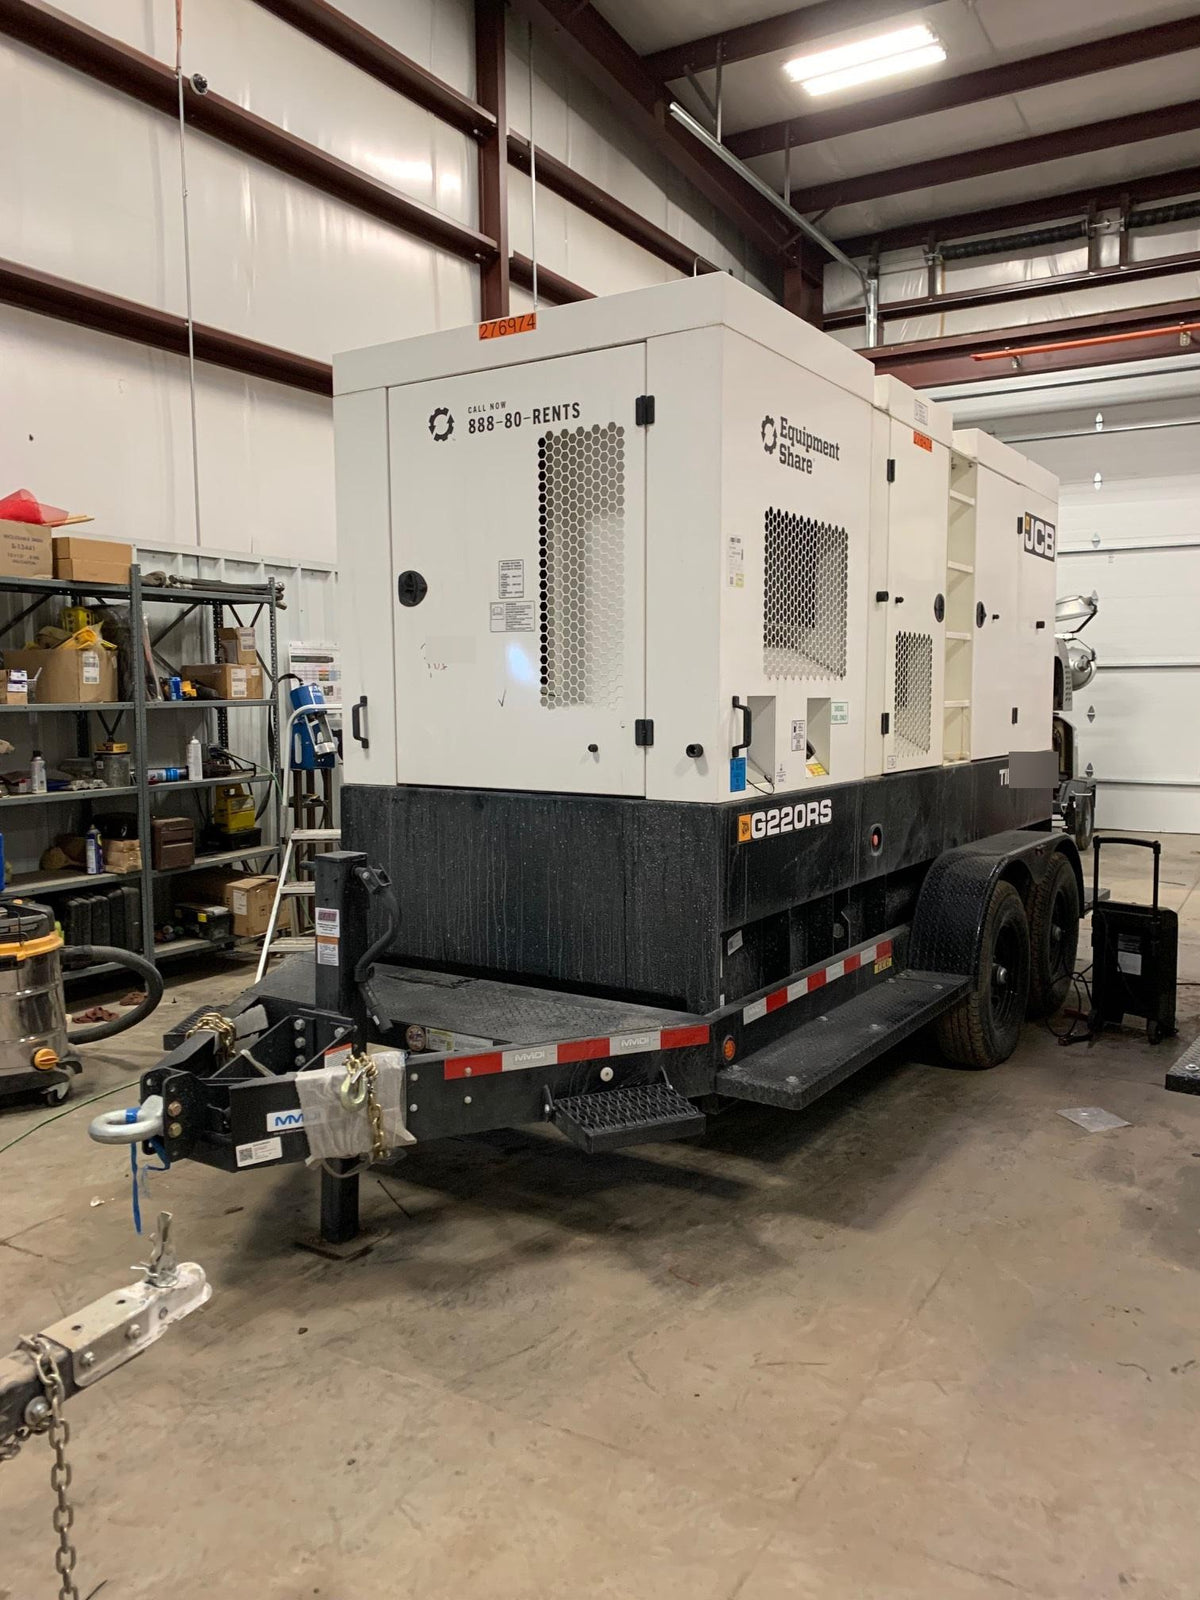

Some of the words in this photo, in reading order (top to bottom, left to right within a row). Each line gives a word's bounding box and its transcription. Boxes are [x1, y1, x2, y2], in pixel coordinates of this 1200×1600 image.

[480, 314, 536, 339] 276974
[468, 404, 486, 413] CALL
[490, 402, 506, 410] NOW
[468, 402, 580, 434] 888-80-RENTS
[780, 416, 840, 461] Equipment
[779, 443, 813, 474] Share
[1025, 515, 1055, 558] JCB
[751, 799, 832, 839] G220RS
[514, 1050, 545, 1062] MMDI
